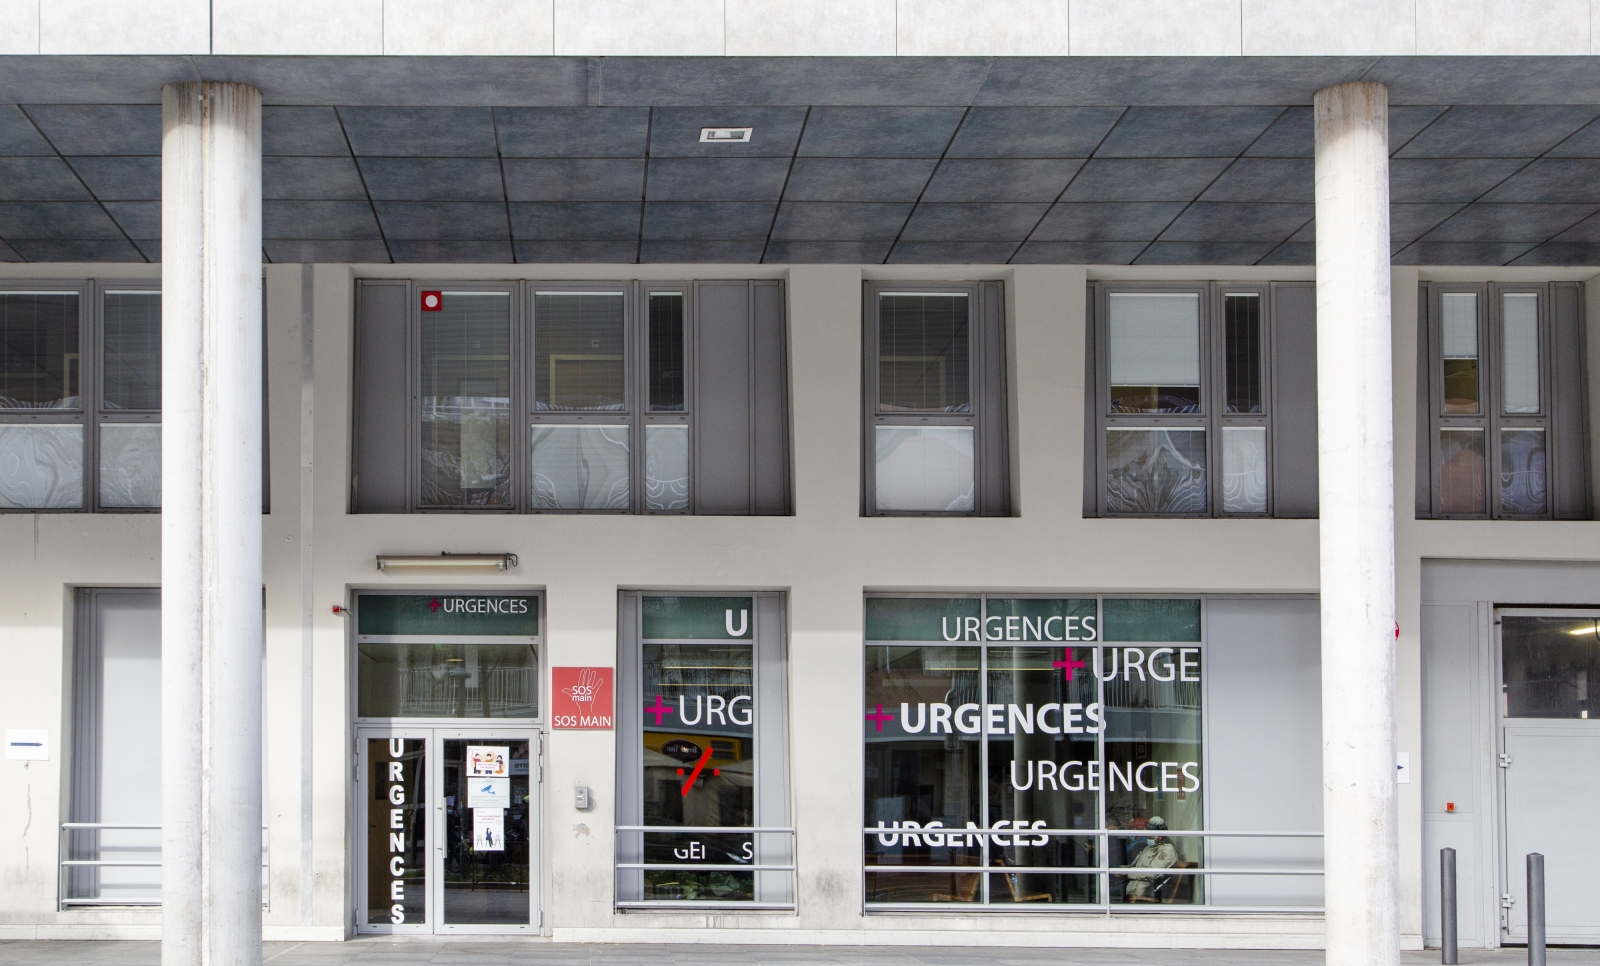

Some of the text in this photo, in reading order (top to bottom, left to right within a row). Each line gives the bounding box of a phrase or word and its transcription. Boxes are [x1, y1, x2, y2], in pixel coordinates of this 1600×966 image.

[443, 599, 528, 613] URGENCES
[725, 609, 748, 636] U
[942, 616, 1097, 641] URGENCES
[1092, 648, 1200, 682] URGE
[572, 685, 592, 695] SOS
[572, 694, 592, 702] main
[554, 715, 611, 727] SOS MAIN
[679, 695, 753, 726] URG
[900, 702, 1107, 734] URGENCES
[1010, 761, 1200, 792] URGENCES
[390, 738, 405, 924] URGENCES
[878, 820, 1050, 847] URGENCES
